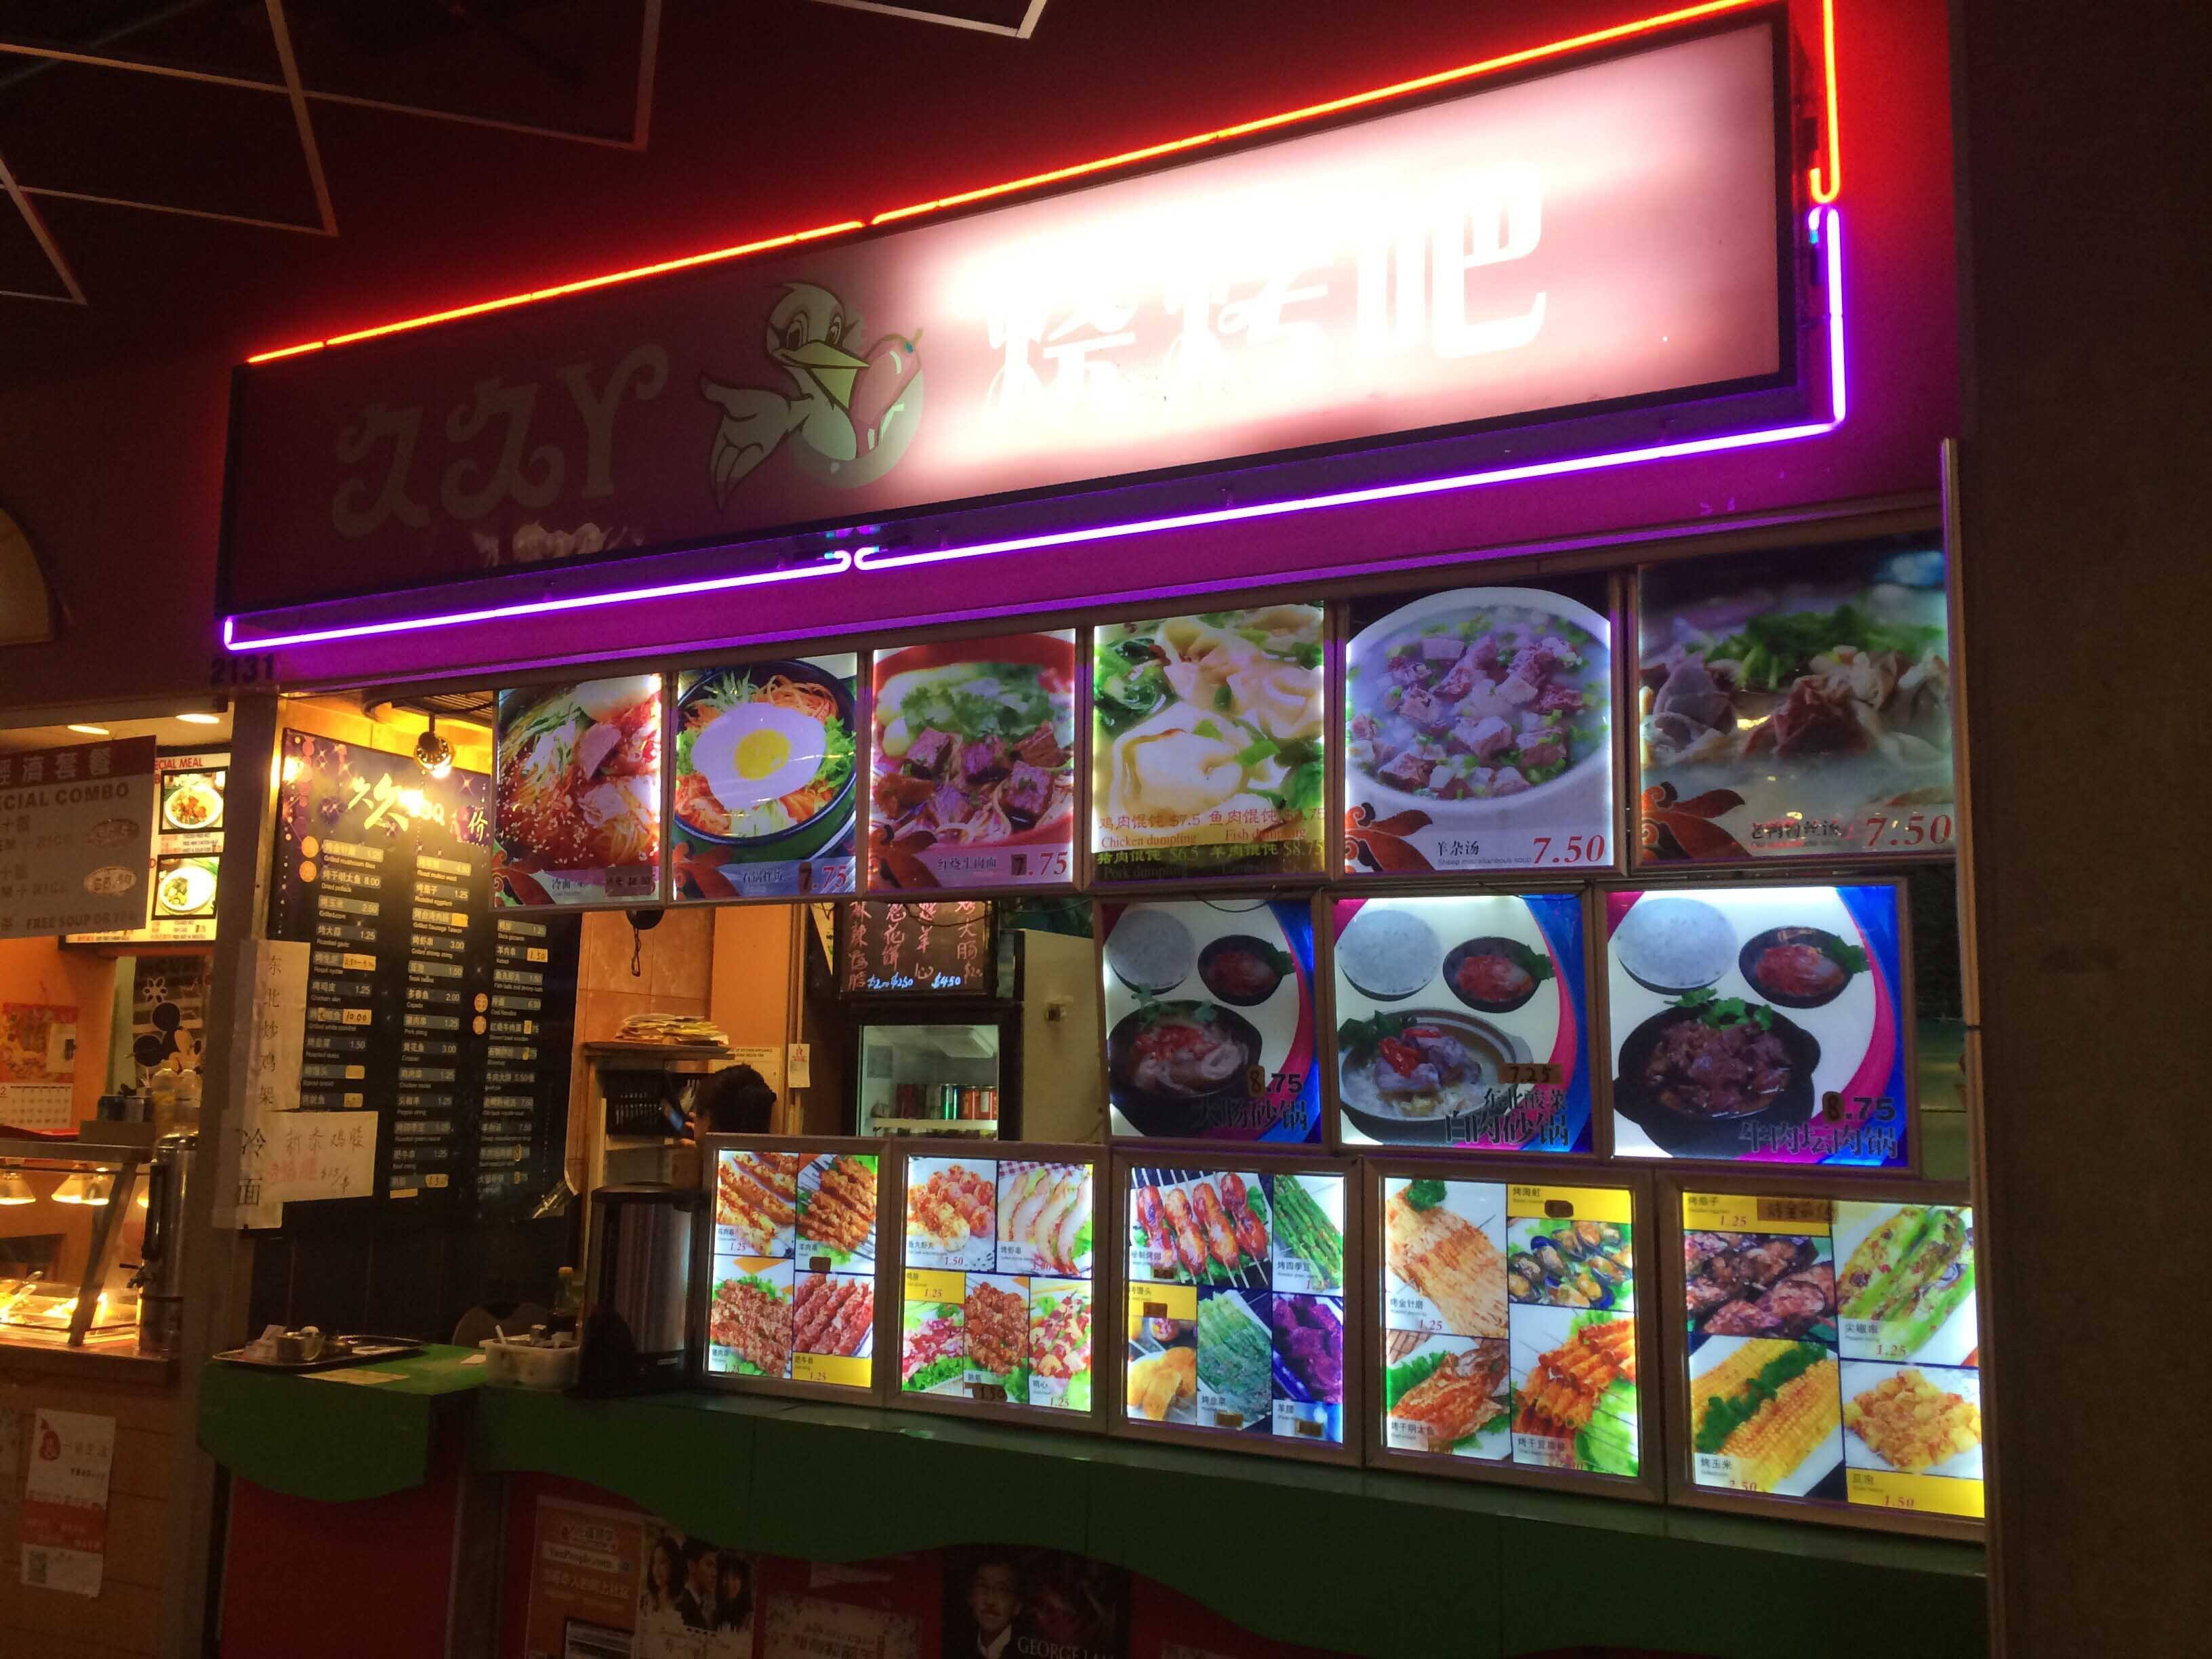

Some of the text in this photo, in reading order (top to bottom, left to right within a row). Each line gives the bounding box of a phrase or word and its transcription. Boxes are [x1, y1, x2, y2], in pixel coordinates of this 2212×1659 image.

[179, 758, 203, 769] MEAL
[0, 782, 129, 811] CIAL COMBO
[1225, 828, 1250, 841] Fish
[1866, 814, 1952, 847] 7.50
[1101, 833, 1197, 849] Chicken dumpling
[1533, 834, 1605, 865] 7.50
[1012, 851, 1068, 876] 7.75
[455, 889, 469, 900] 1.25
[26, 917, 55, 930] FREE
[59, 914, 91, 928] SOUP
[359, 930, 375, 940] 1.25
[450, 940, 465, 950] 3.00
[354, 985, 371, 995] 1.25
[445, 992, 461, 1002] 2.00
[1250, 1069, 1303, 1093] 8.75
[1509, 1066, 1553, 1084] 7.25
[237, 1127, 266, 1207] 冷面
[1721, 1215, 1746, 1227] 1.25
[730, 1242, 747, 1251] 1.25
[944, 1256, 964, 1266] 1.50
[1305, 1279, 1330, 1290] 1.25
[924, 1288, 942, 1298] 1.25
[1418, 1319, 1443, 1331] 1.25
[1876, 1344, 1906, 1356] 1.25
[810, 1371, 826, 1381] 1.25
[1049, 1397, 1069, 1408] 1.25
[1728, 1479, 1758, 1492] 2.50
[1885, 1495, 1914, 1509] 1.50
